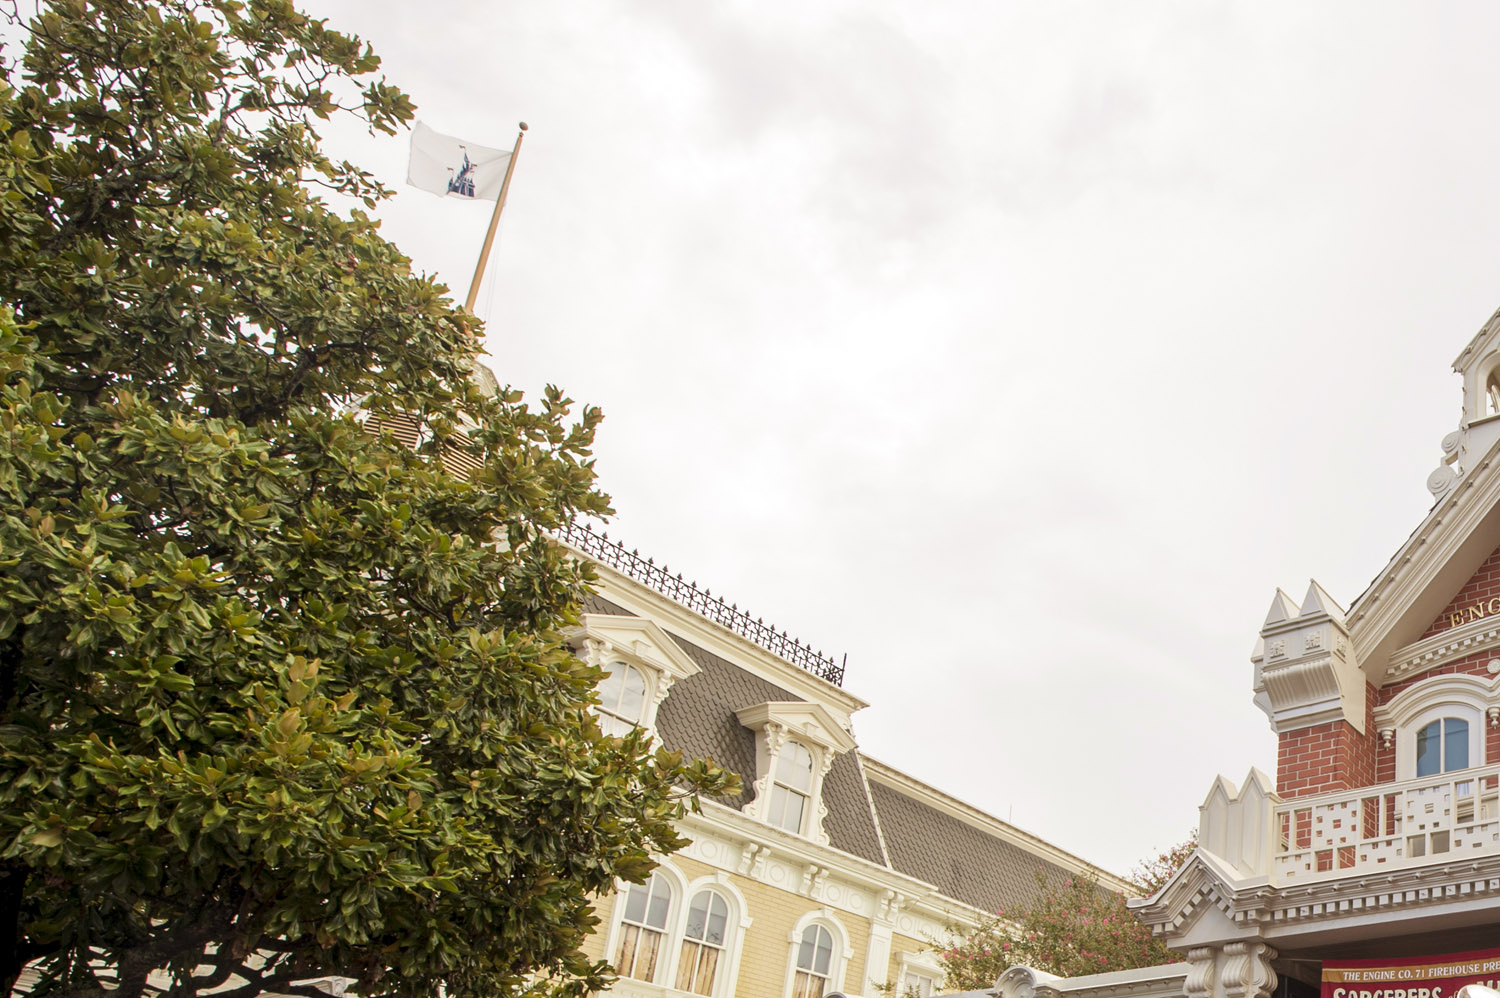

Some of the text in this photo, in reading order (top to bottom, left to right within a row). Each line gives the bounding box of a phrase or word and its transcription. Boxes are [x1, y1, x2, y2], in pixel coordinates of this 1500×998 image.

[1343, 971, 1361, 981] THE
[1363, 970, 1396, 981] ENGINE
[1398, 969, 1413, 979] CO.
[1415, 969, 1425, 978] 71
[1428, 963, 1480, 977] FIREHOUSE
